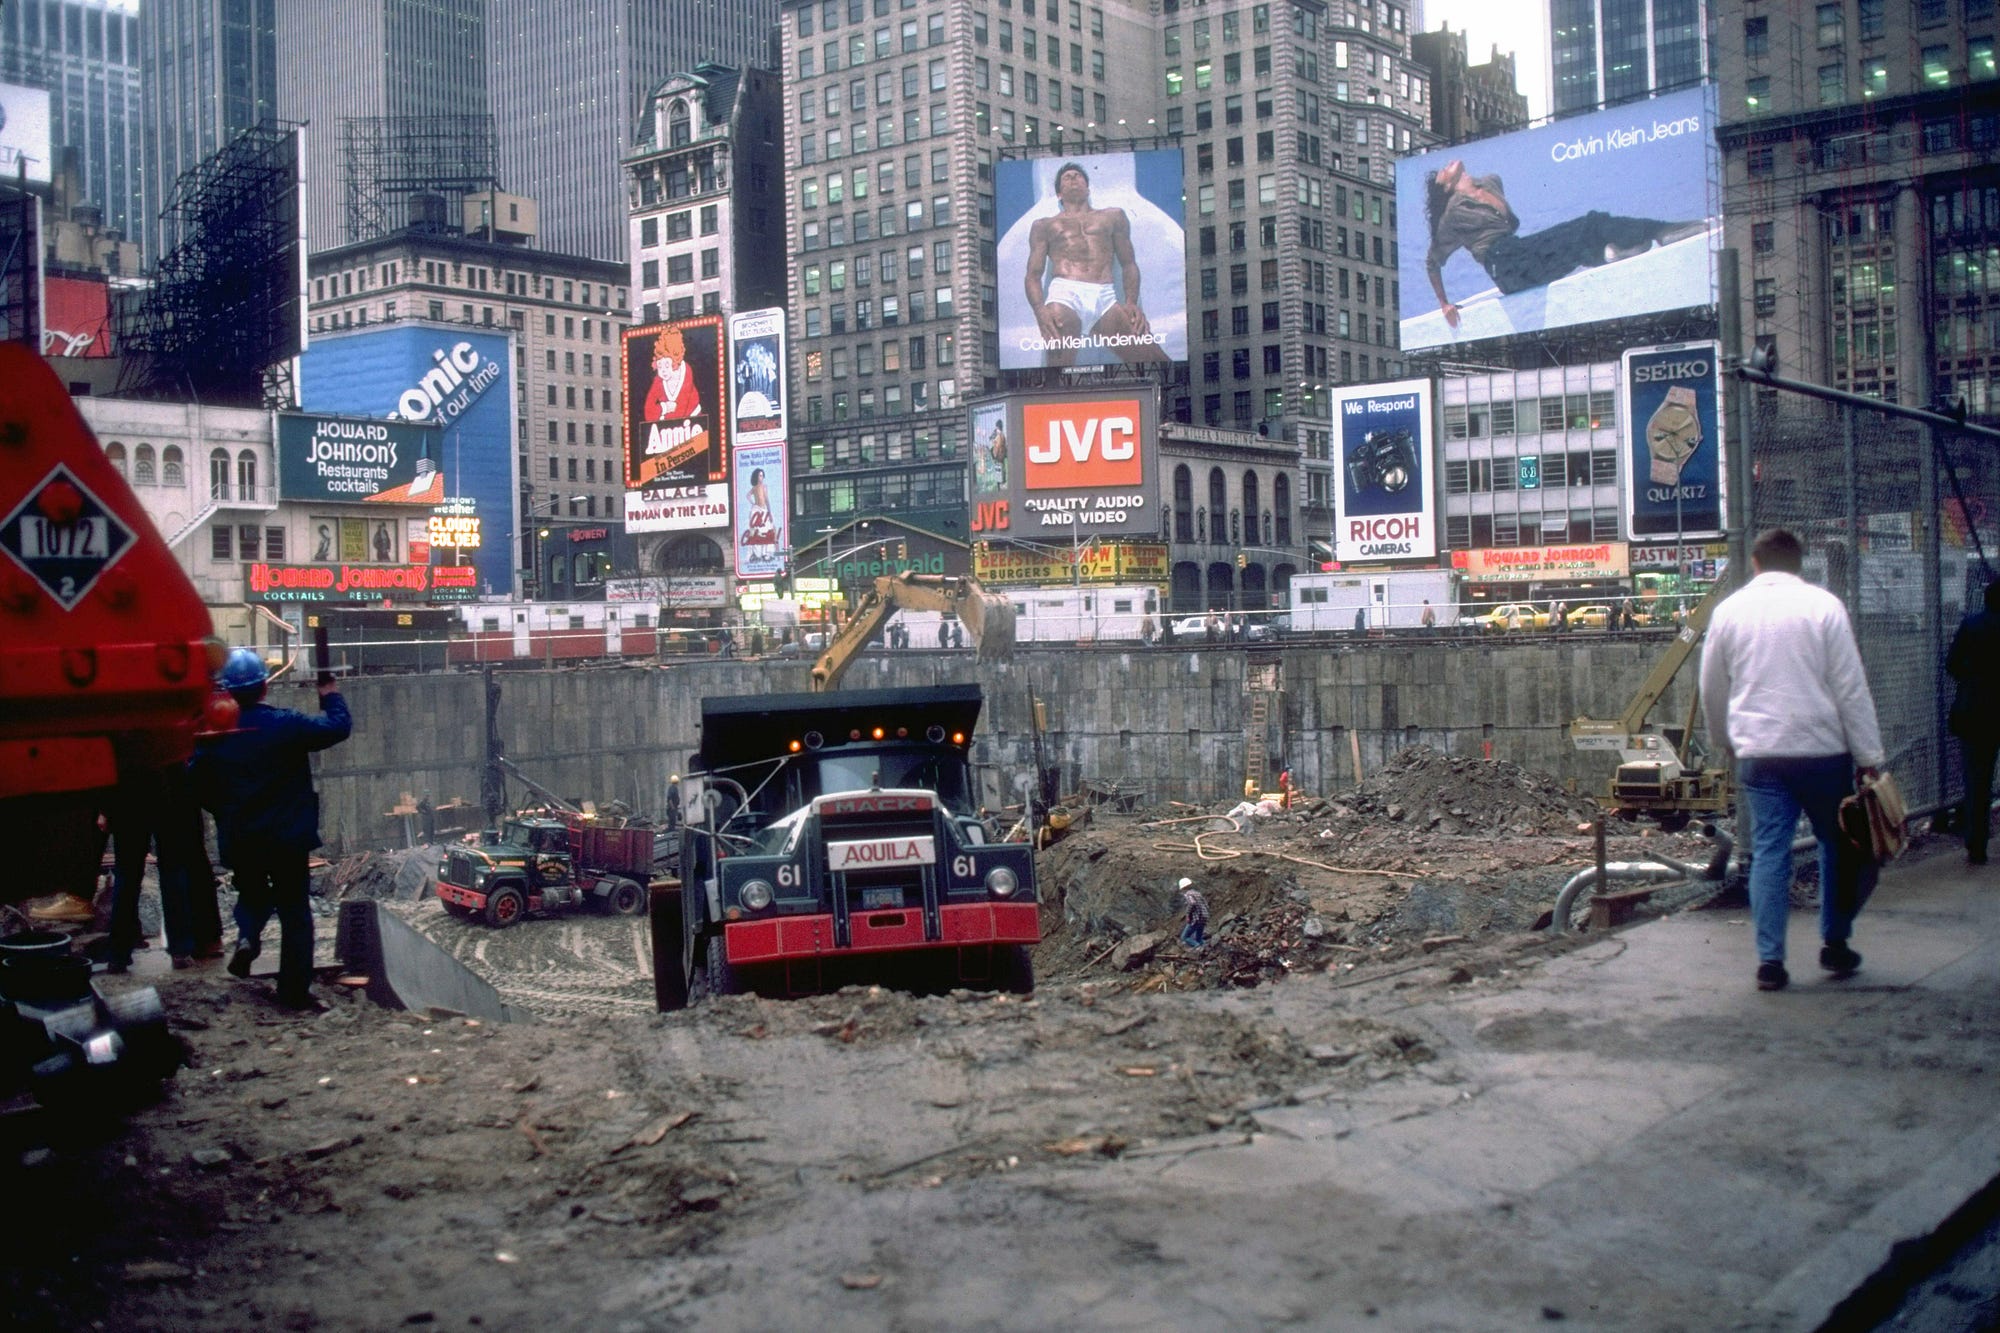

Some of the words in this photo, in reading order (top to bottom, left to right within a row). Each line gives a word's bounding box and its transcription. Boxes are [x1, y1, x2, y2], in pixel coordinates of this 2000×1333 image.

[1552, 136, 1603, 162] Calvin
[1607, 126, 1646, 150] Klein
[1647, 116, 1700, 142] Jeans
[1019, 336, 1061, 351] Calvin
[1062, 334, 1091, 349] Klein
[1094, 331, 1168, 348] Underwear
[387, 341, 479, 420] onic
[1635, 359, 1708, 383] SEIKO
[447, 388, 470, 416] our
[469, 361, 499, 393] time
[1345, 401, 1363, 415] We
[1368, 396, 1414, 413] Respond
[317, 422, 387, 440] HOWARD
[645, 419, 703, 454] Annie
[1029, 417, 1134, 463] JVC
[306, 436, 397, 467] JOHNSON'S
[655, 462, 667, 473] In
[668, 446, 696, 467] Person
[317, 461, 388, 480] Restaurants
[327, 479, 379, 493] cocktails
[642, 485, 708, 501] PALACE
[1647, 484, 1706, 502] QUARTZ
[434, 503, 475, 514] weather
[628, 509, 661, 520] WOMAN
[662, 508, 675, 518] OF
[677, 506, 696, 517] THE
[698, 503, 727, 516] YEAR
[1025, 496, 1089, 512] QUALITY
[1095, 495, 1143, 508] AUDIO
[429, 517, 480, 532] CLOUDY
[971, 500, 1009, 531] JVC
[1041, 512, 1074, 525] AND
[1080, 511, 1127, 523] VIDEO
[1350, 517, 1419, 542] RICOH
[430, 532, 480, 547] COLDER
[1360, 542, 1411, 556] CAMERAS
[1483, 549, 1540, 566] HOWARD
[249, 564, 334, 592] HOWARD
[336, 565, 428, 592] JOHNSON'S
[989, 566, 1051, 580] BURGERS
[60, 576, 75, 596] 2
[264, 592, 325, 600] COCKTAILS
[835, 801, 918, 813] MACK
[844, 841, 922, 864] AQUILA
[777, 864, 800, 886] 61
[954, 855, 976, 877] 61
